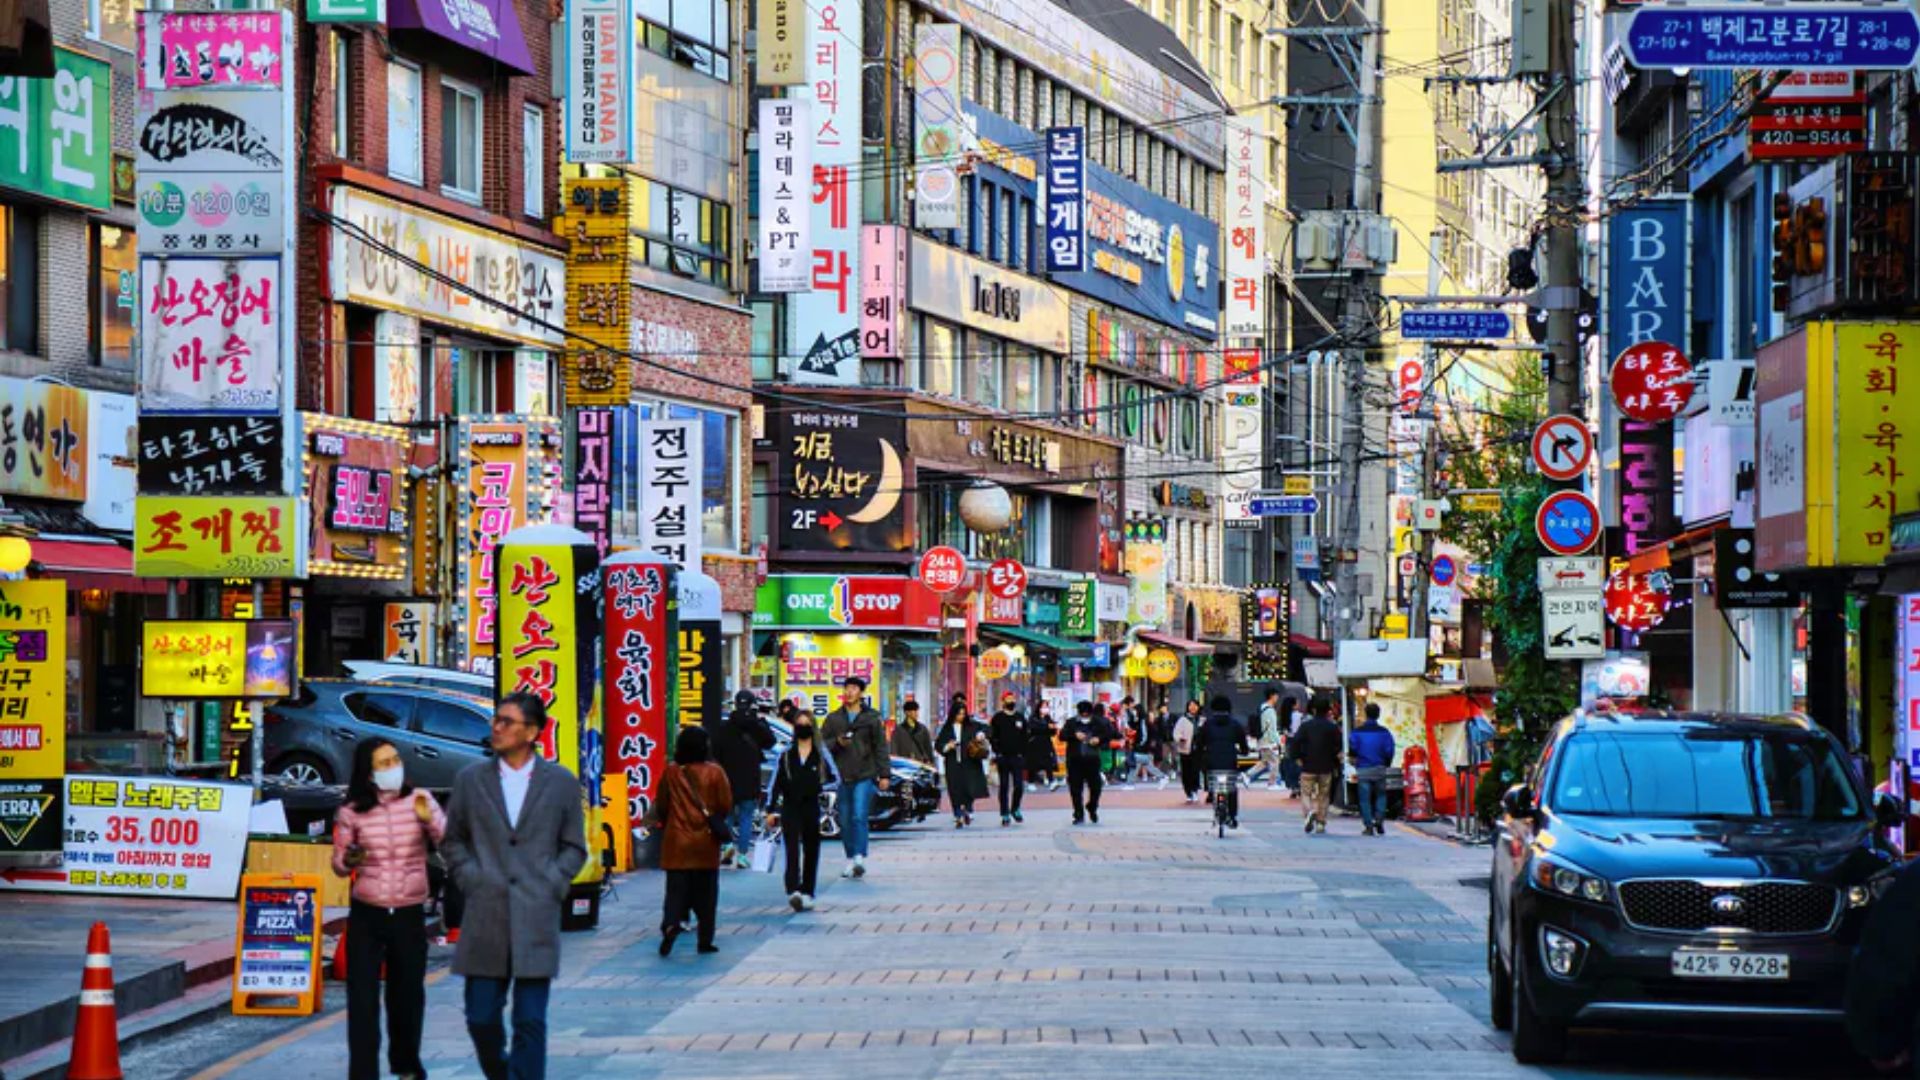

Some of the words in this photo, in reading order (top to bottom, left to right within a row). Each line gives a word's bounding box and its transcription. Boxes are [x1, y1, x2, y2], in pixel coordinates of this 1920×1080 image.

[1664, 21, 1693, 33] 27-1
[1702, 16, 1849, 47] 백제고분로7길
[1858, 21, 1887, 33] 28-1
[1638, 37, 1676, 49] 27-10
[1871, 37, 1911, 50] 28-48
[1706, 50, 1809, 63] Baekjegobun-ro
[1813, 50, 1843, 63] 7-gil
[601, 73, 616, 144] HANA
[775, 106, 793, 200] 필라테스
[141, 192, 182, 214] 10분
[190, 191, 270, 217] 1200원
[1051, 132, 1079, 266] 보드게임
[776, 206, 791, 225] &
[769, 232, 799, 250] PT
[811, 164, 852, 313] 헤라
[1232, 226, 1258, 311] 헤라
[1625, 217, 1667, 346] BAR
[150, 272, 272, 328] 산오징어
[864, 295, 890, 353] 헤어
[172, 333, 252, 385] 마을
[1624, 352, 1684, 374] 타로
[1624, 390, 1684, 413] 사주
[142, 429, 209, 460] 타로
[209, 417, 275, 449] 하는
[142, 507, 283, 555] 조개찜
[791, 510, 816, 529] 2F
[928, 554, 956, 567] 24시
[925, 569, 958, 585] 편의점
[992, 562, 1022, 596] 탕
[787, 593, 827, 610] ONE
[853, 593, 903, 611] STOP
[153, 634, 233, 657] 산오징어
[189, 664, 232, 686] 마을
[123, 782, 224, 812] 노래주점
[104, 815, 199, 846] 35,000
[257, 916, 297, 929] PIZZA
[1729, 958, 1780, 976] 9628
